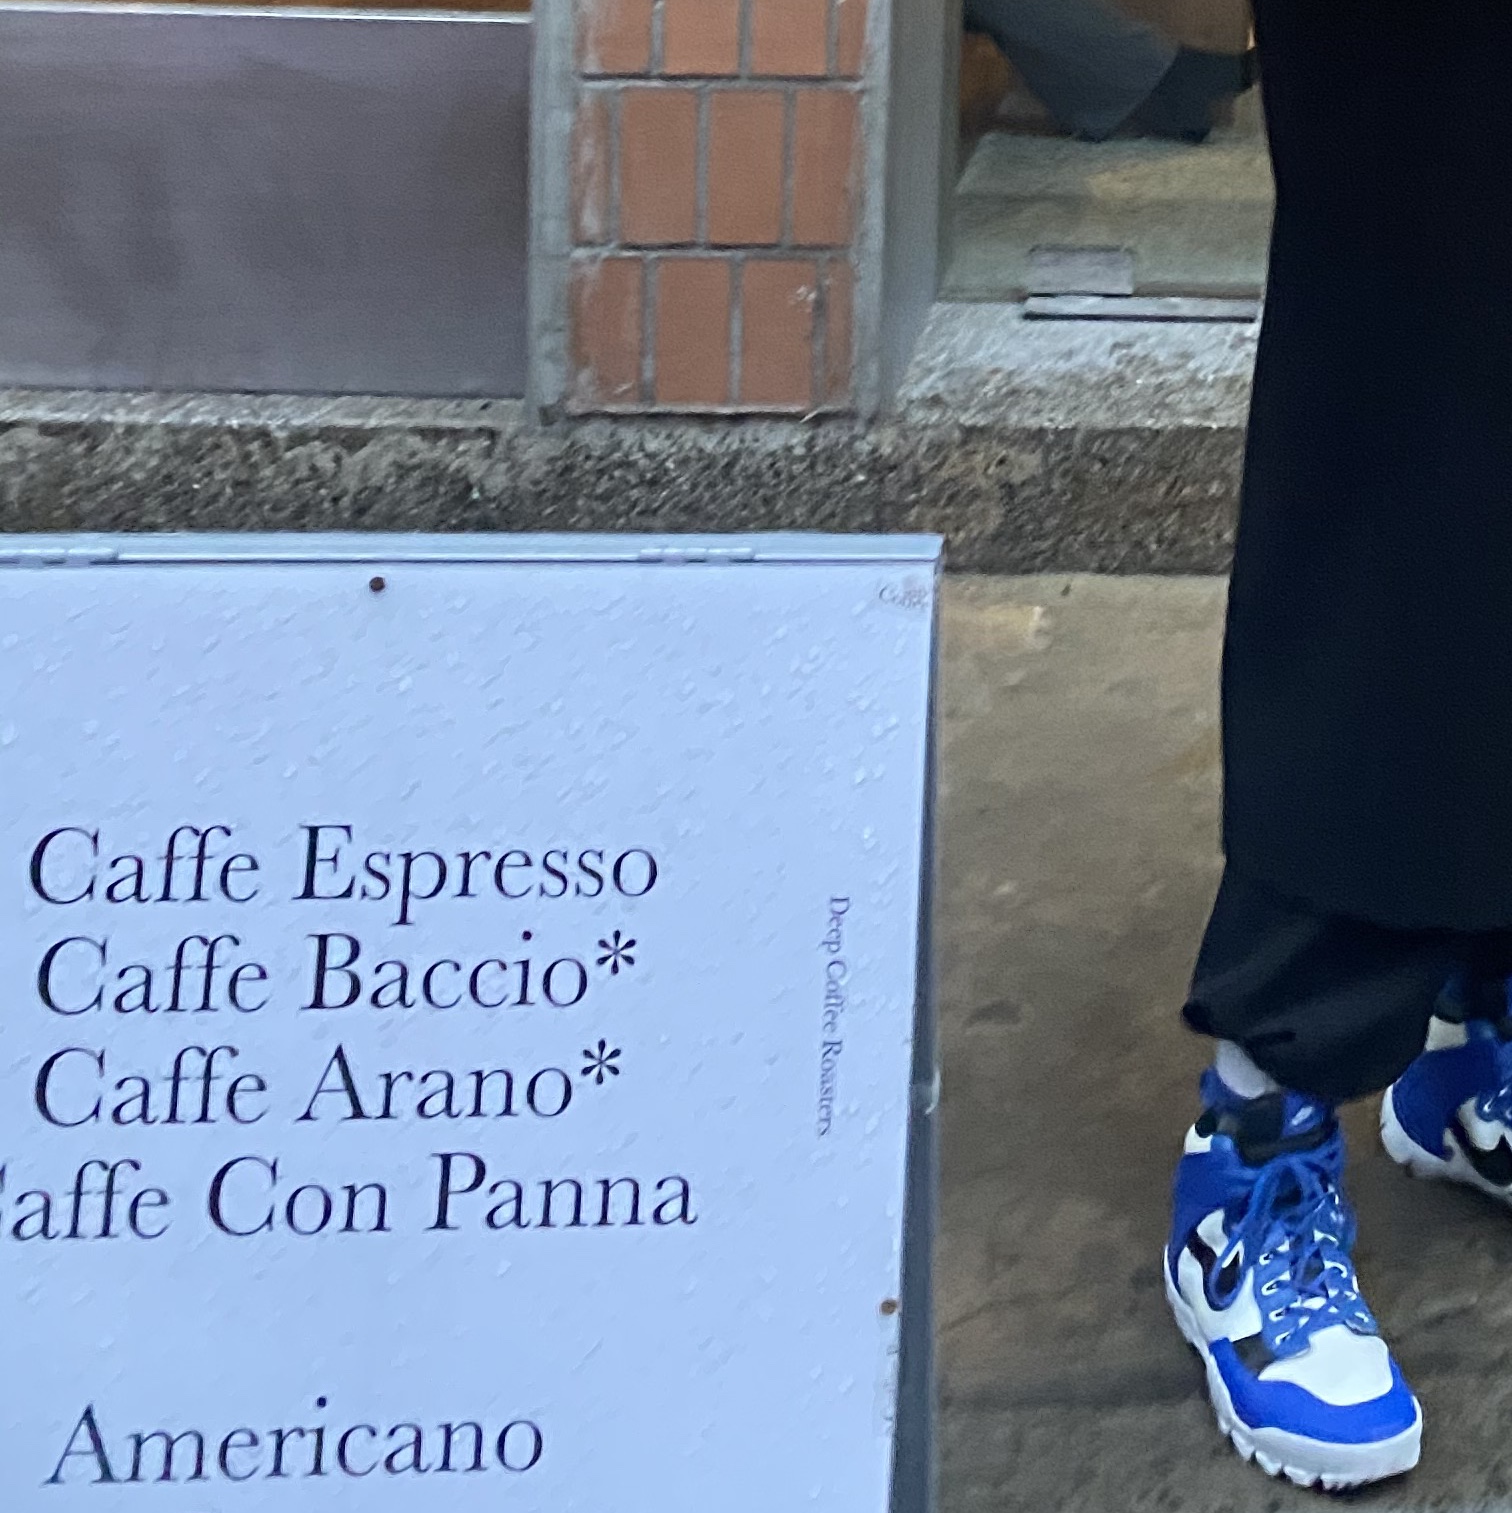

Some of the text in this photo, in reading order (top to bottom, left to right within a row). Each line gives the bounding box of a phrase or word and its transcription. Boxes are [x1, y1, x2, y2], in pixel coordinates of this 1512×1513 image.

[28, 824, 659, 926] Caffe Espresso
[36, 934, 269, 1017] Caffe
[816, 895, 851, 1137] Deep Coffee Roasters
[34, 1045, 268, 1129] Caffe
[0, 1151, 699, 1241] affe Con Panna
[43, 1395, 544, 1487] Americano
